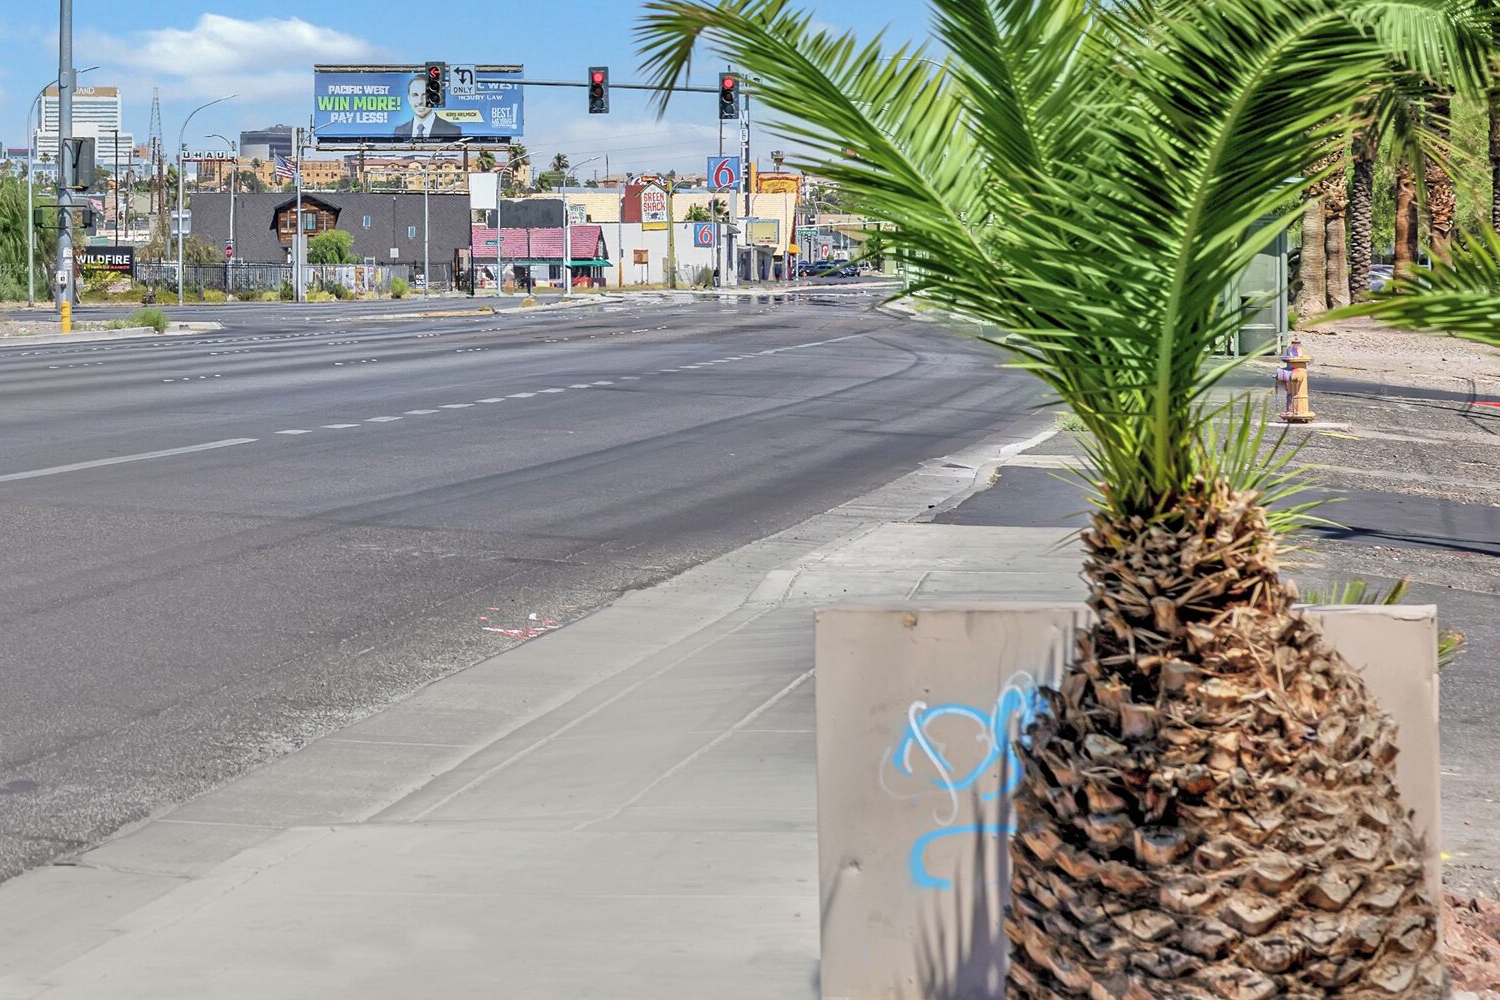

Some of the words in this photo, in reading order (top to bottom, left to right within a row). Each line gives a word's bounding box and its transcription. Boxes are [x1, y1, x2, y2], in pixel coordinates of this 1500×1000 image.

[328, 85, 363, 95] PACIFIC
[364, 85, 390, 95] WEST
[453, 86, 473, 94] ONLY
[317, 96, 350, 111] WIN
[353, 96, 402, 111] MORE!
[330, 112, 353, 123] PAY
[356, 112, 388, 123] LESS!
[713, 157, 735, 188] 6
[699, 224, 714, 246] 6
[76, 254, 131, 264] WILDFIRE
